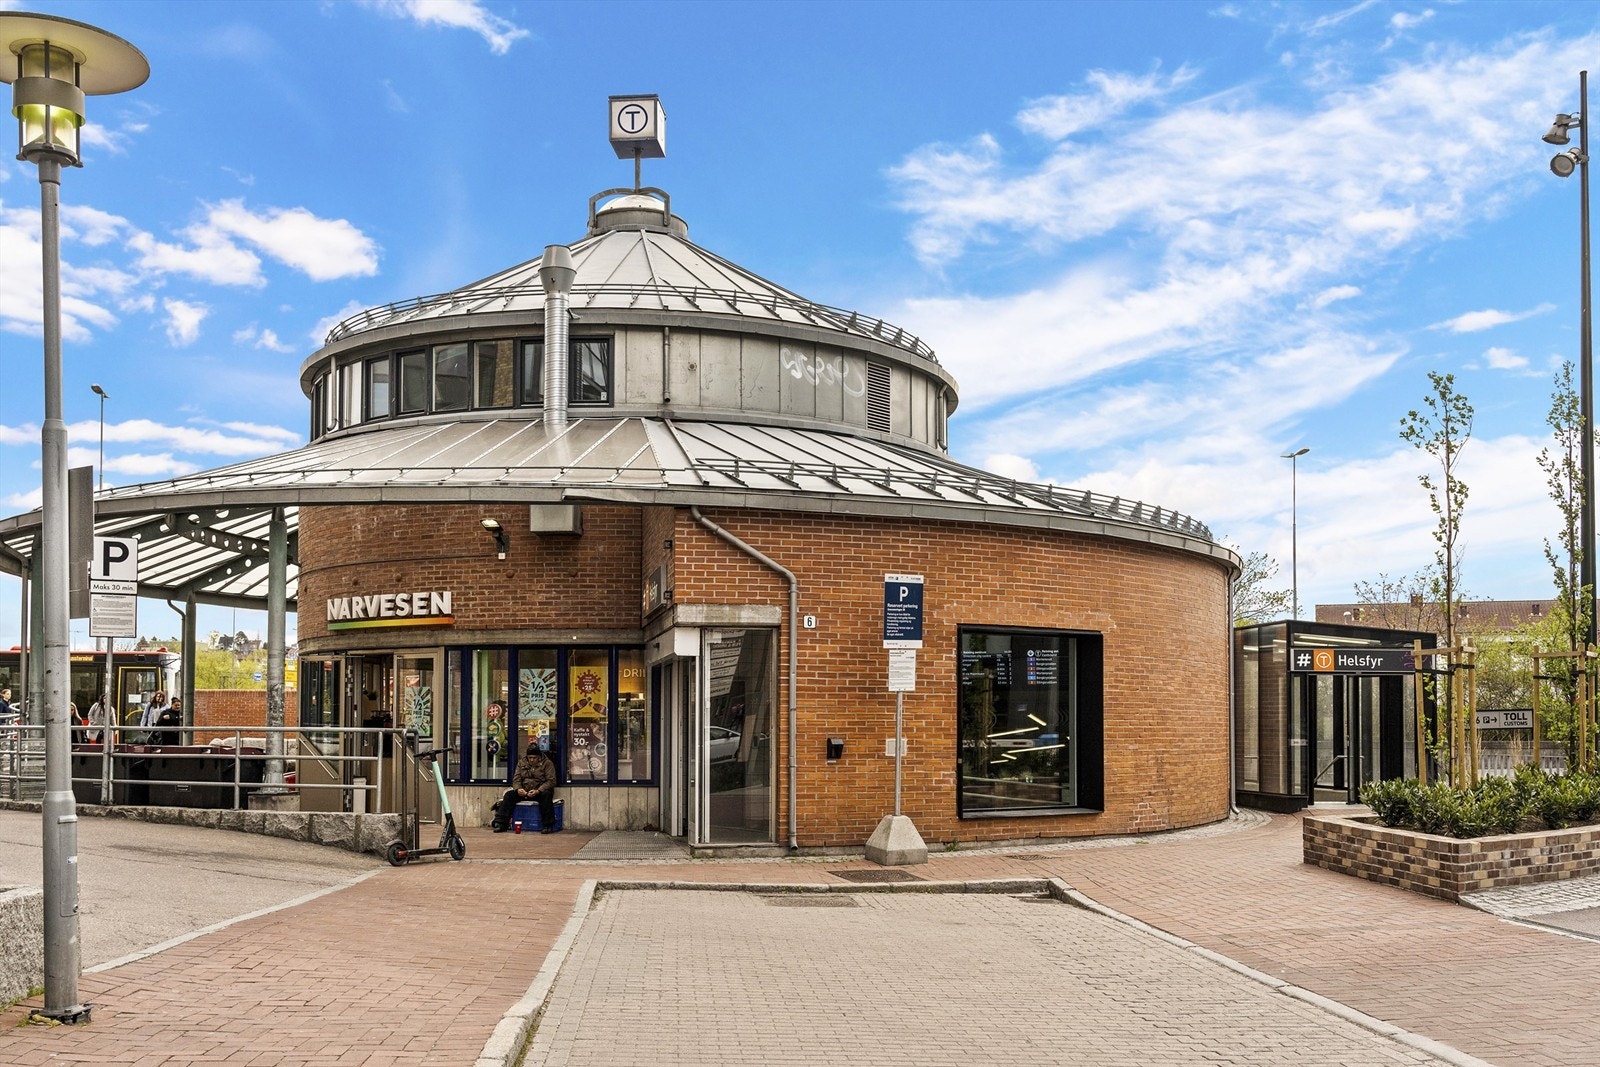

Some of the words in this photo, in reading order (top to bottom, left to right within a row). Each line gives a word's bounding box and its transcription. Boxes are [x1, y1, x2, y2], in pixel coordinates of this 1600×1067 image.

[626, 111, 640, 130] T
[103, 541, 129, 576] P
[900, 586, 908, 601] P
[327, 590, 452, 620] NARVESEN
[807, 617, 812, 626] 6
[1338, 654, 1384, 668] Helsfyr
[531, 681, 544, 693] 1/2
